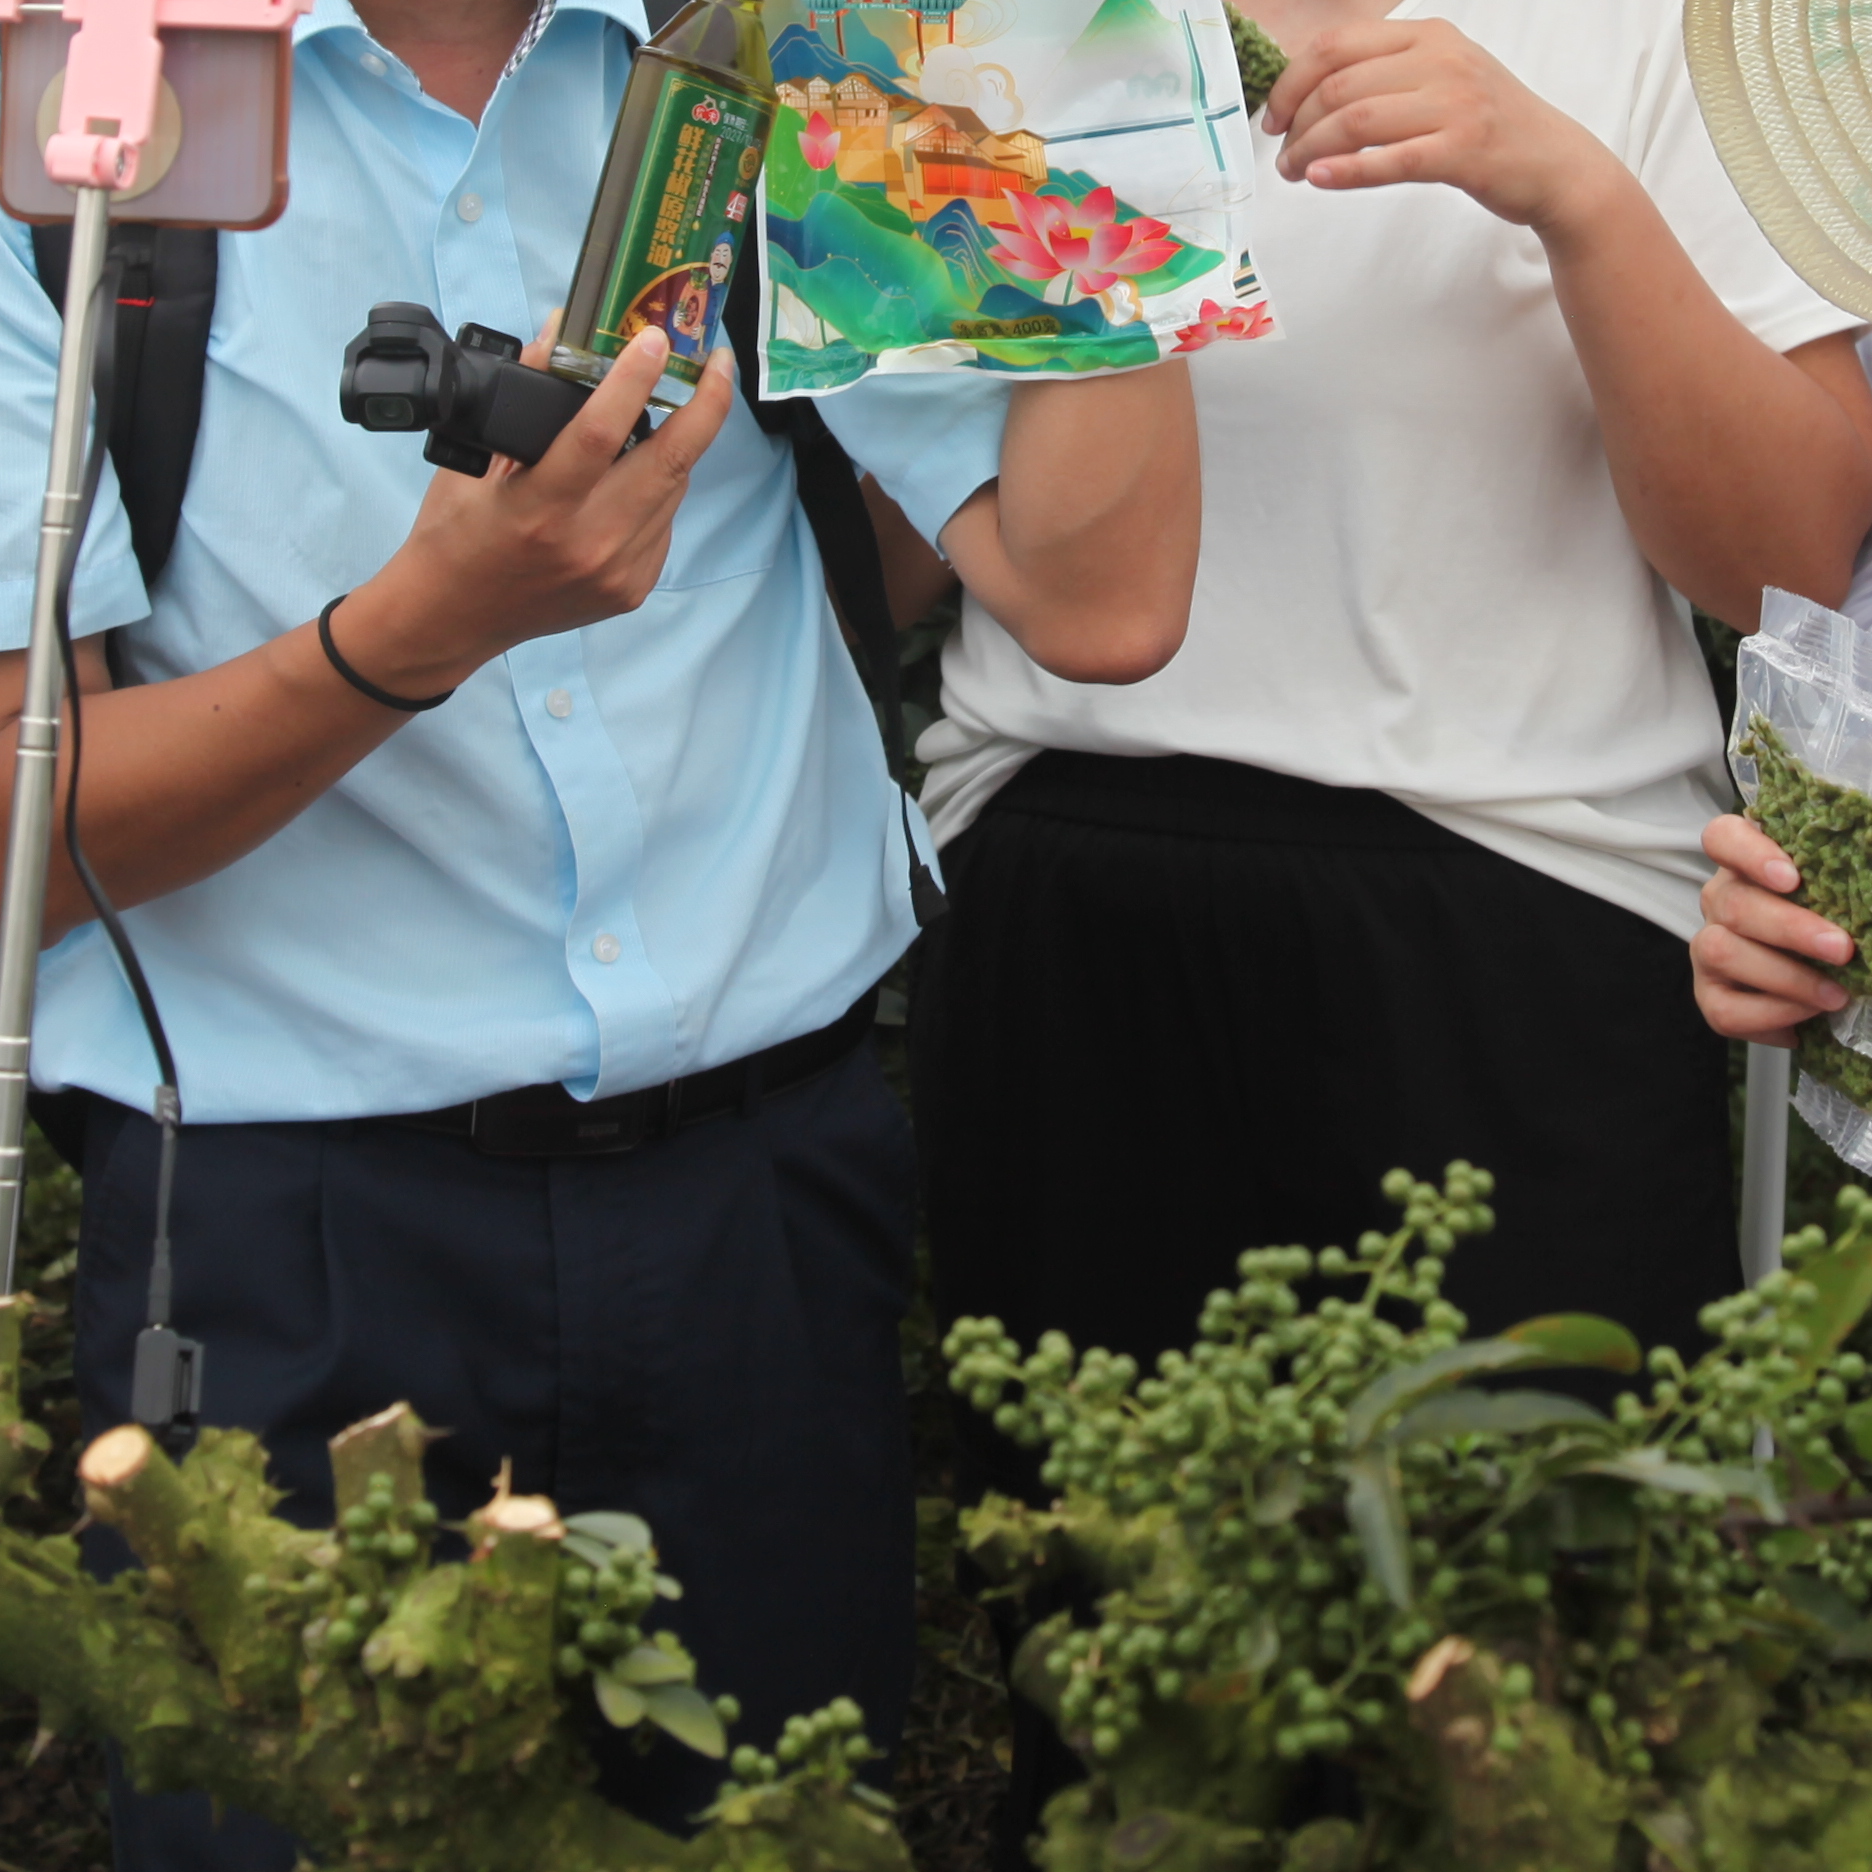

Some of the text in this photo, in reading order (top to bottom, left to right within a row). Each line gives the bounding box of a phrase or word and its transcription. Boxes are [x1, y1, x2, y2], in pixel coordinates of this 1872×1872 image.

[646, 122, 706, 269] 鲜花椒原浆油
